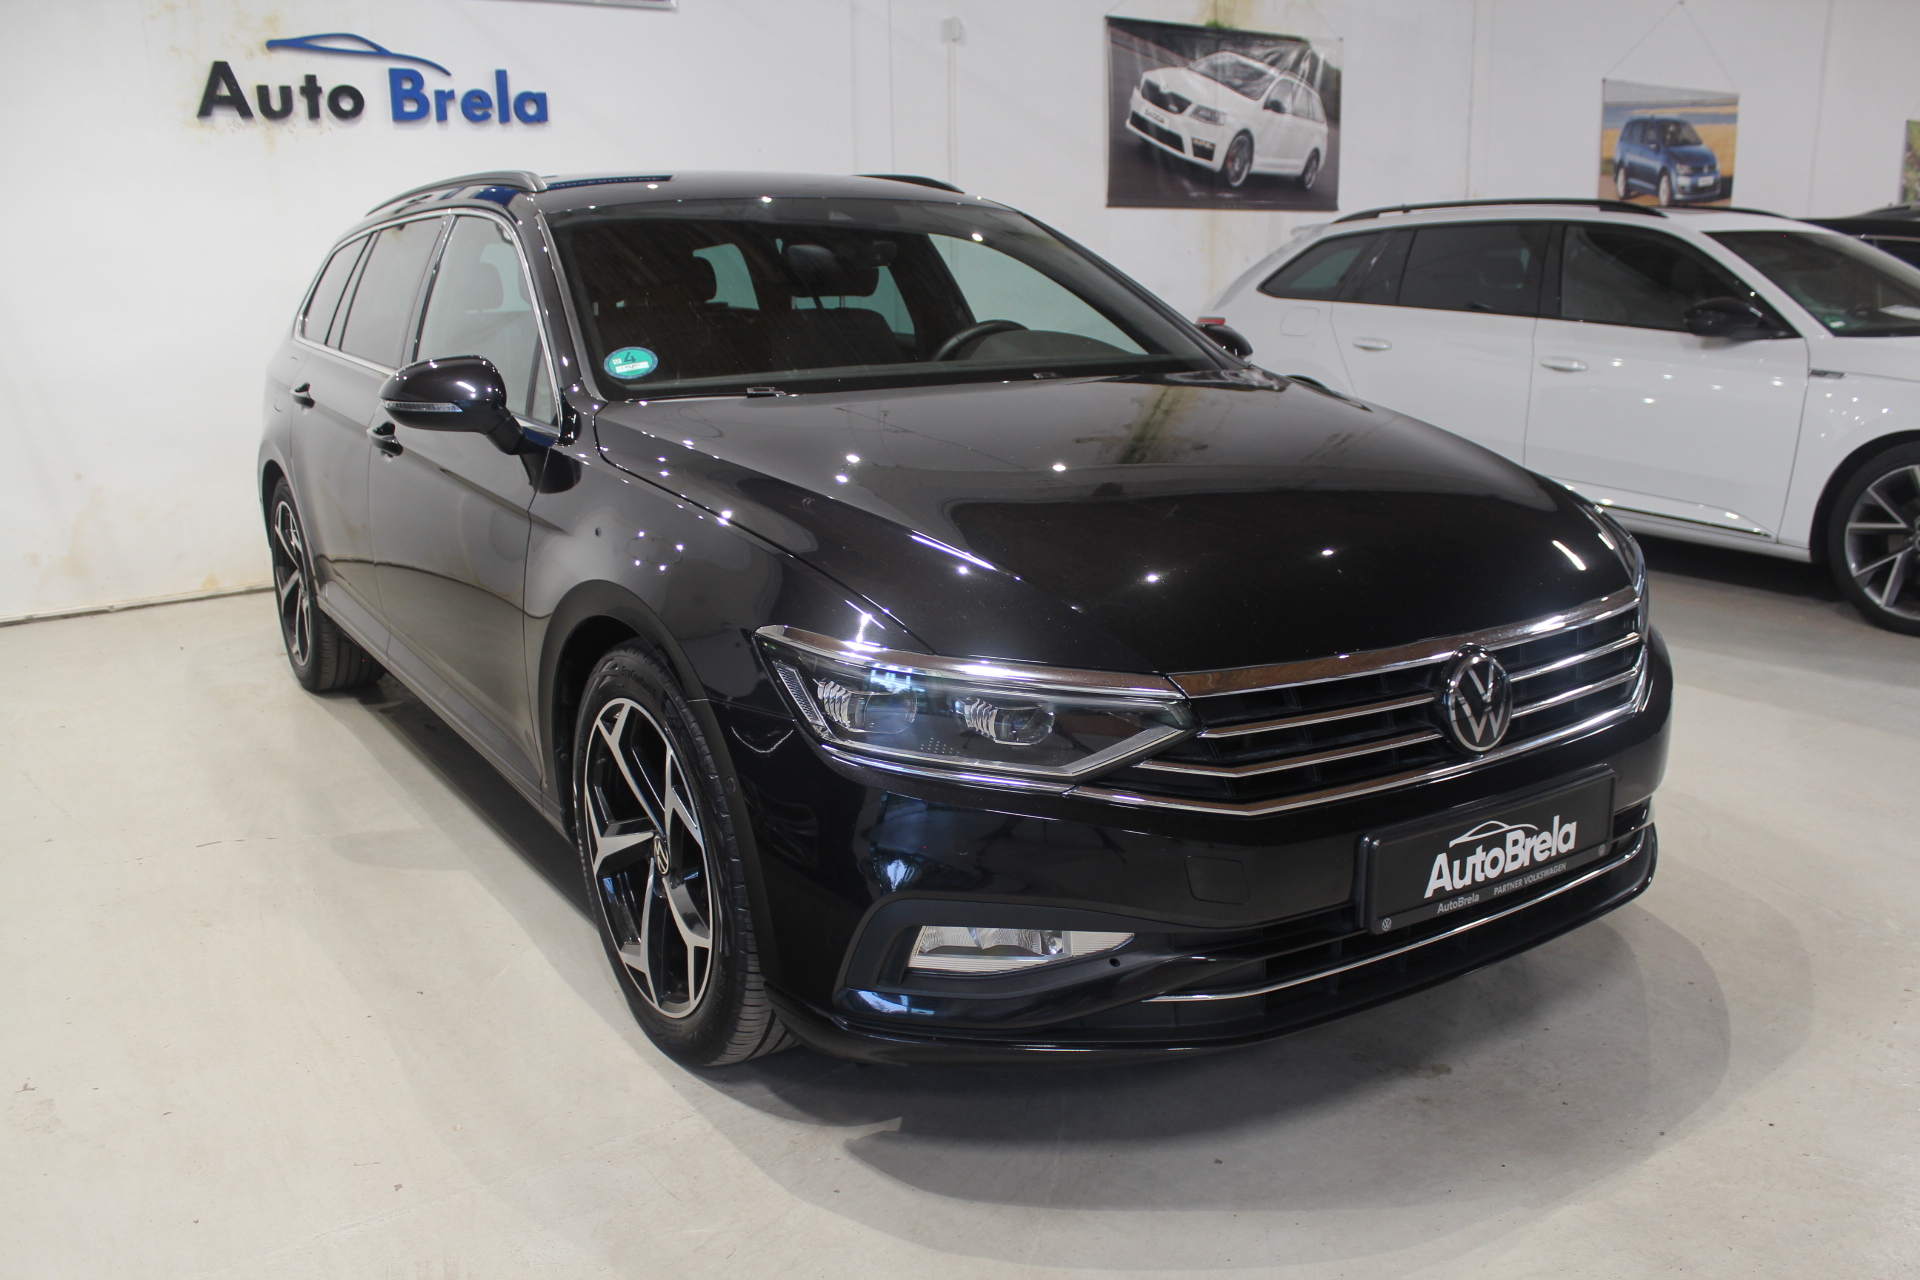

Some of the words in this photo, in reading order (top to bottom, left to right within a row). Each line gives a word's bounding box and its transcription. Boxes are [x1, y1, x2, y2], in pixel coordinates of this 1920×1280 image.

[197, 60, 365, 120] Auto
[388, 67, 549, 125] Brela
[624, 351, 636, 362] 4
[1423, 815, 1578, 899] AutoBrela
[1493, 878, 1523, 896] PARTNER
[1523, 862, 1567, 885] VOLKSWAGEN
[1436, 892, 1480, 914] AutoBrela
